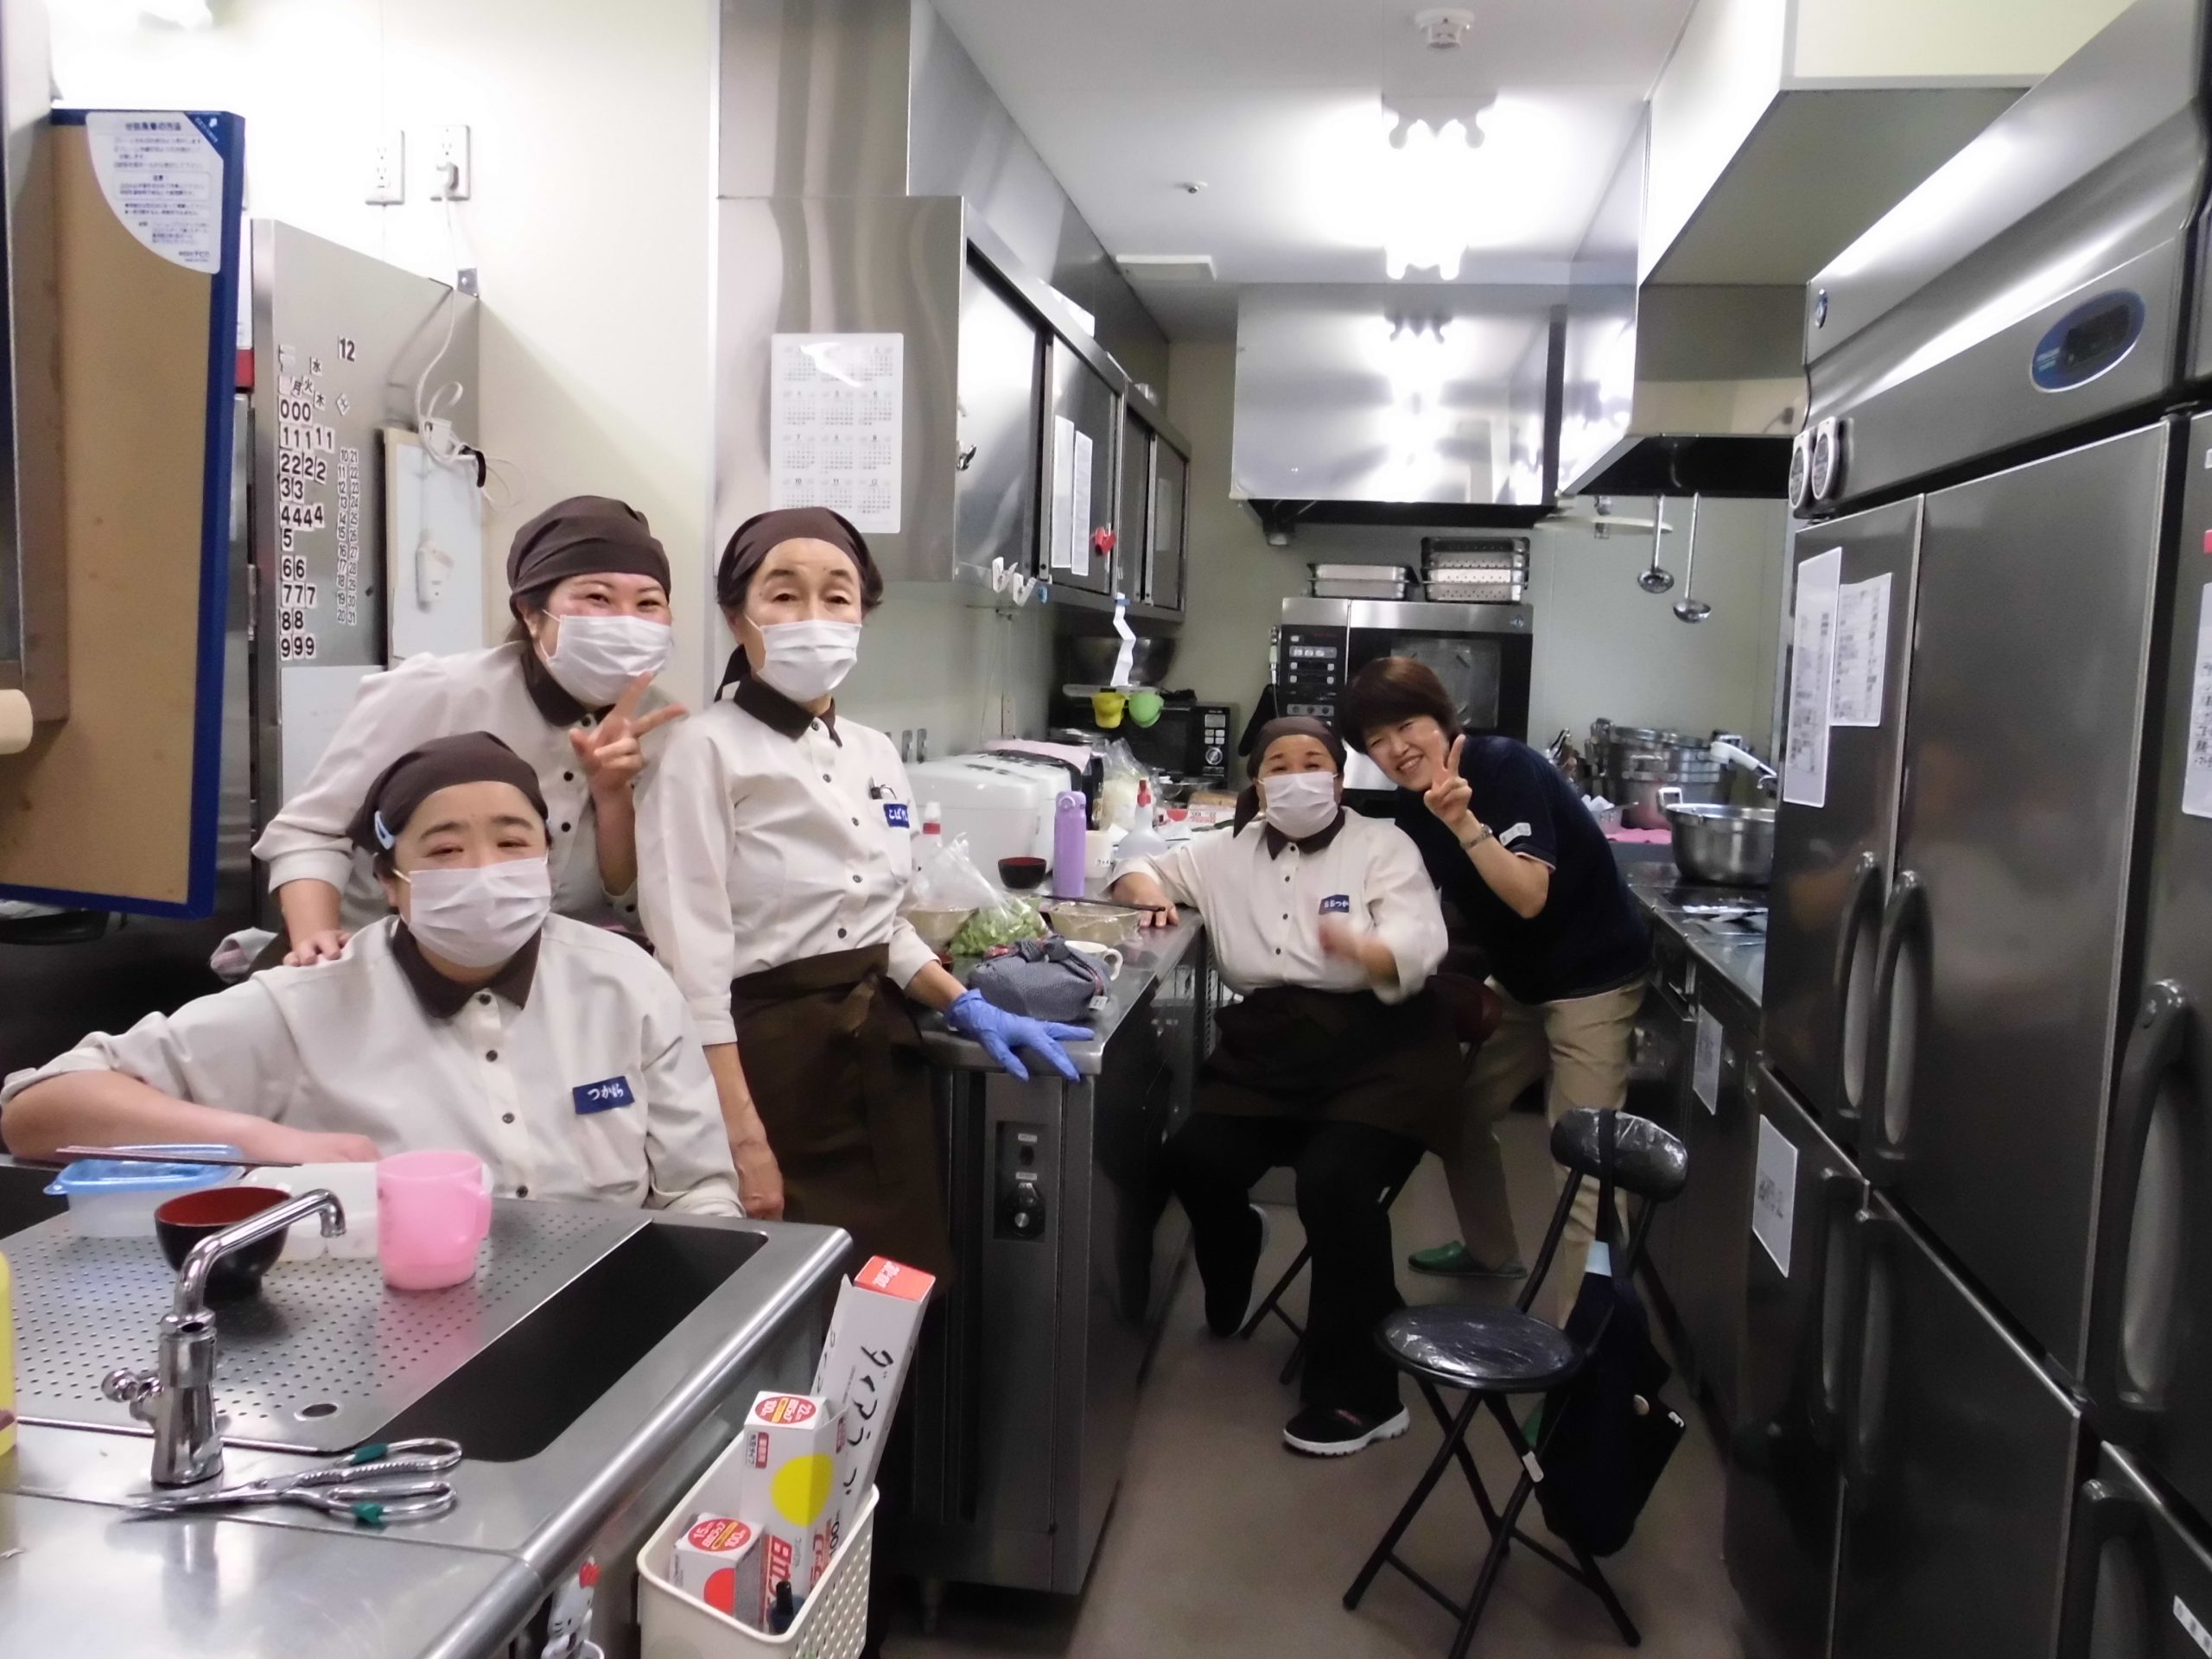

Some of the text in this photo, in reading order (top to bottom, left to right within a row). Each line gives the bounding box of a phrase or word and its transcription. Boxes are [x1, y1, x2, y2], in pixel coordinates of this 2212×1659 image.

[340, 338, 355, 363] 12
[313, 359, 321, 372] 水
[316, 394, 324, 407] 木
[283, 528, 292, 548] 5
